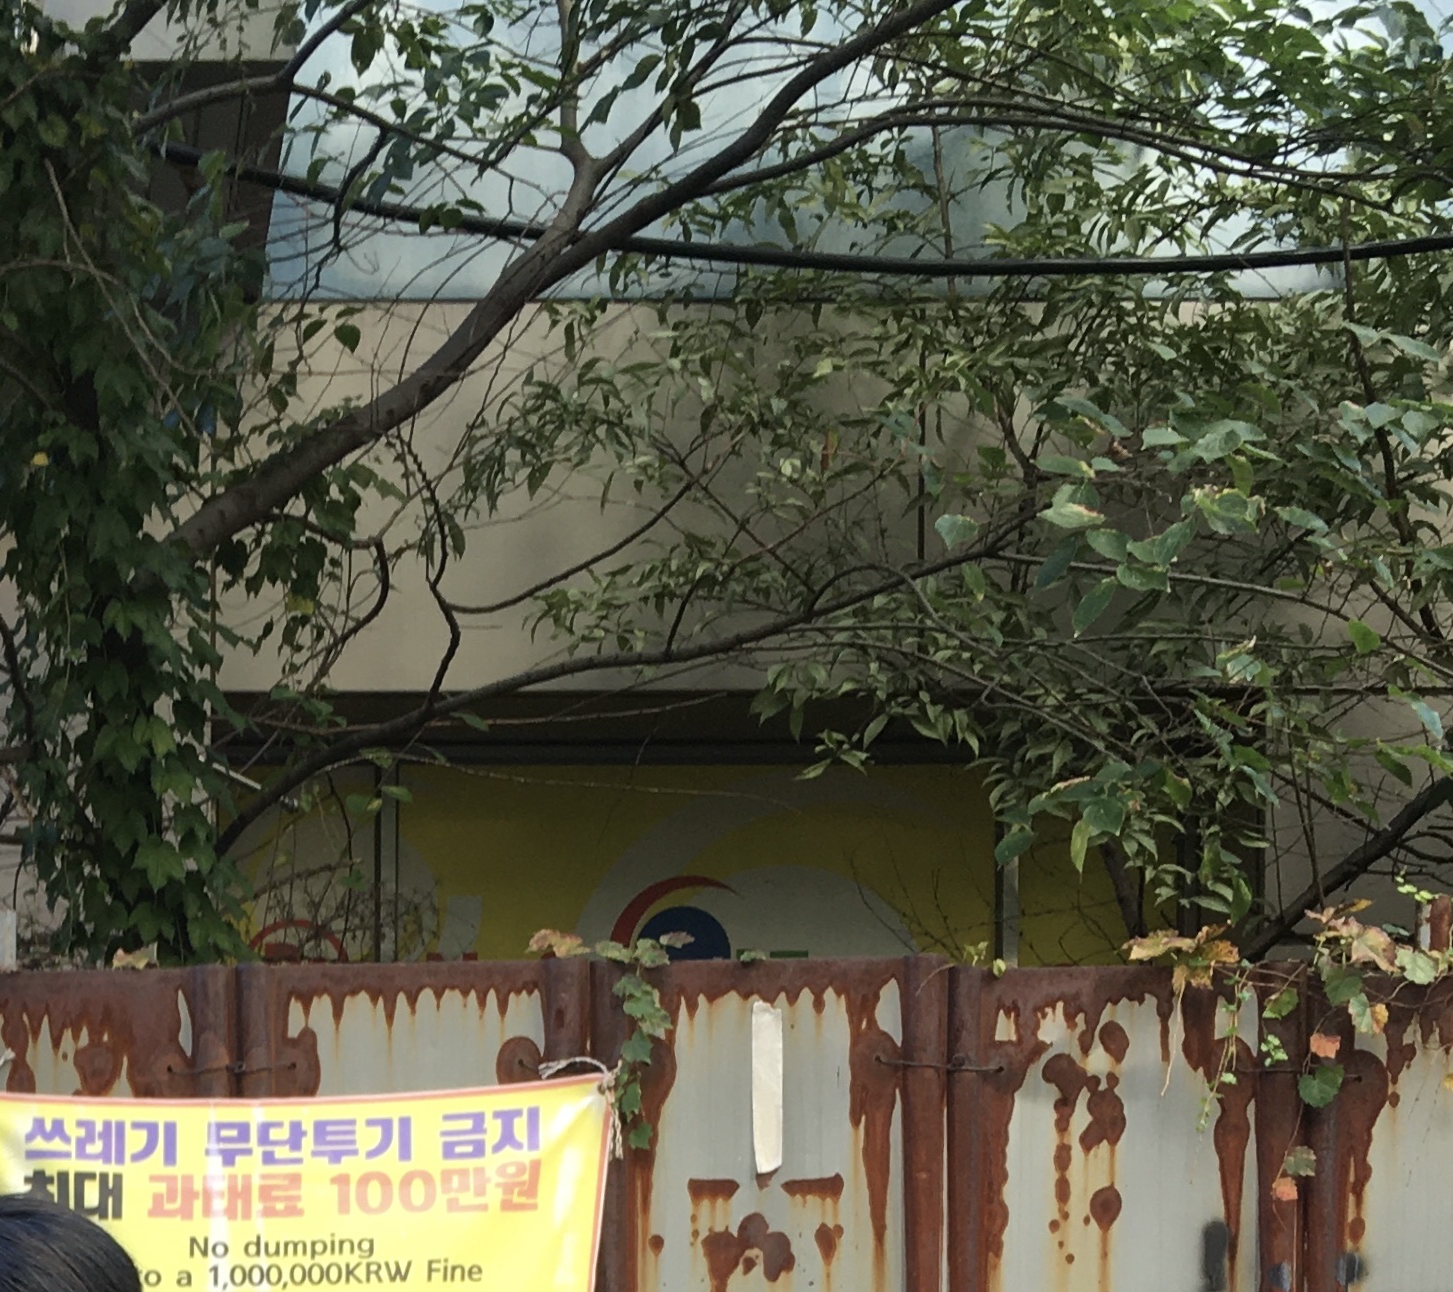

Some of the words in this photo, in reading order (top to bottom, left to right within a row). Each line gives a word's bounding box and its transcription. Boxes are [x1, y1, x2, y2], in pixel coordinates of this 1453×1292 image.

[24, 1117, 178, 1167] 쓰레기
[204, 1115, 412, 1168] 무단투기
[440, 1106, 541, 1161] 금지
[147, 1172, 304, 1222] 과태료
[329, 1159, 542, 1217] 100만원
[189, 1236, 229, 1258] No
[244, 1233, 375, 1261] dumping
[176, 1268, 192, 1288] a
[209, 1260, 412, 1291] 1,000,000KRW
[427, 1258, 483, 1284] Fine
